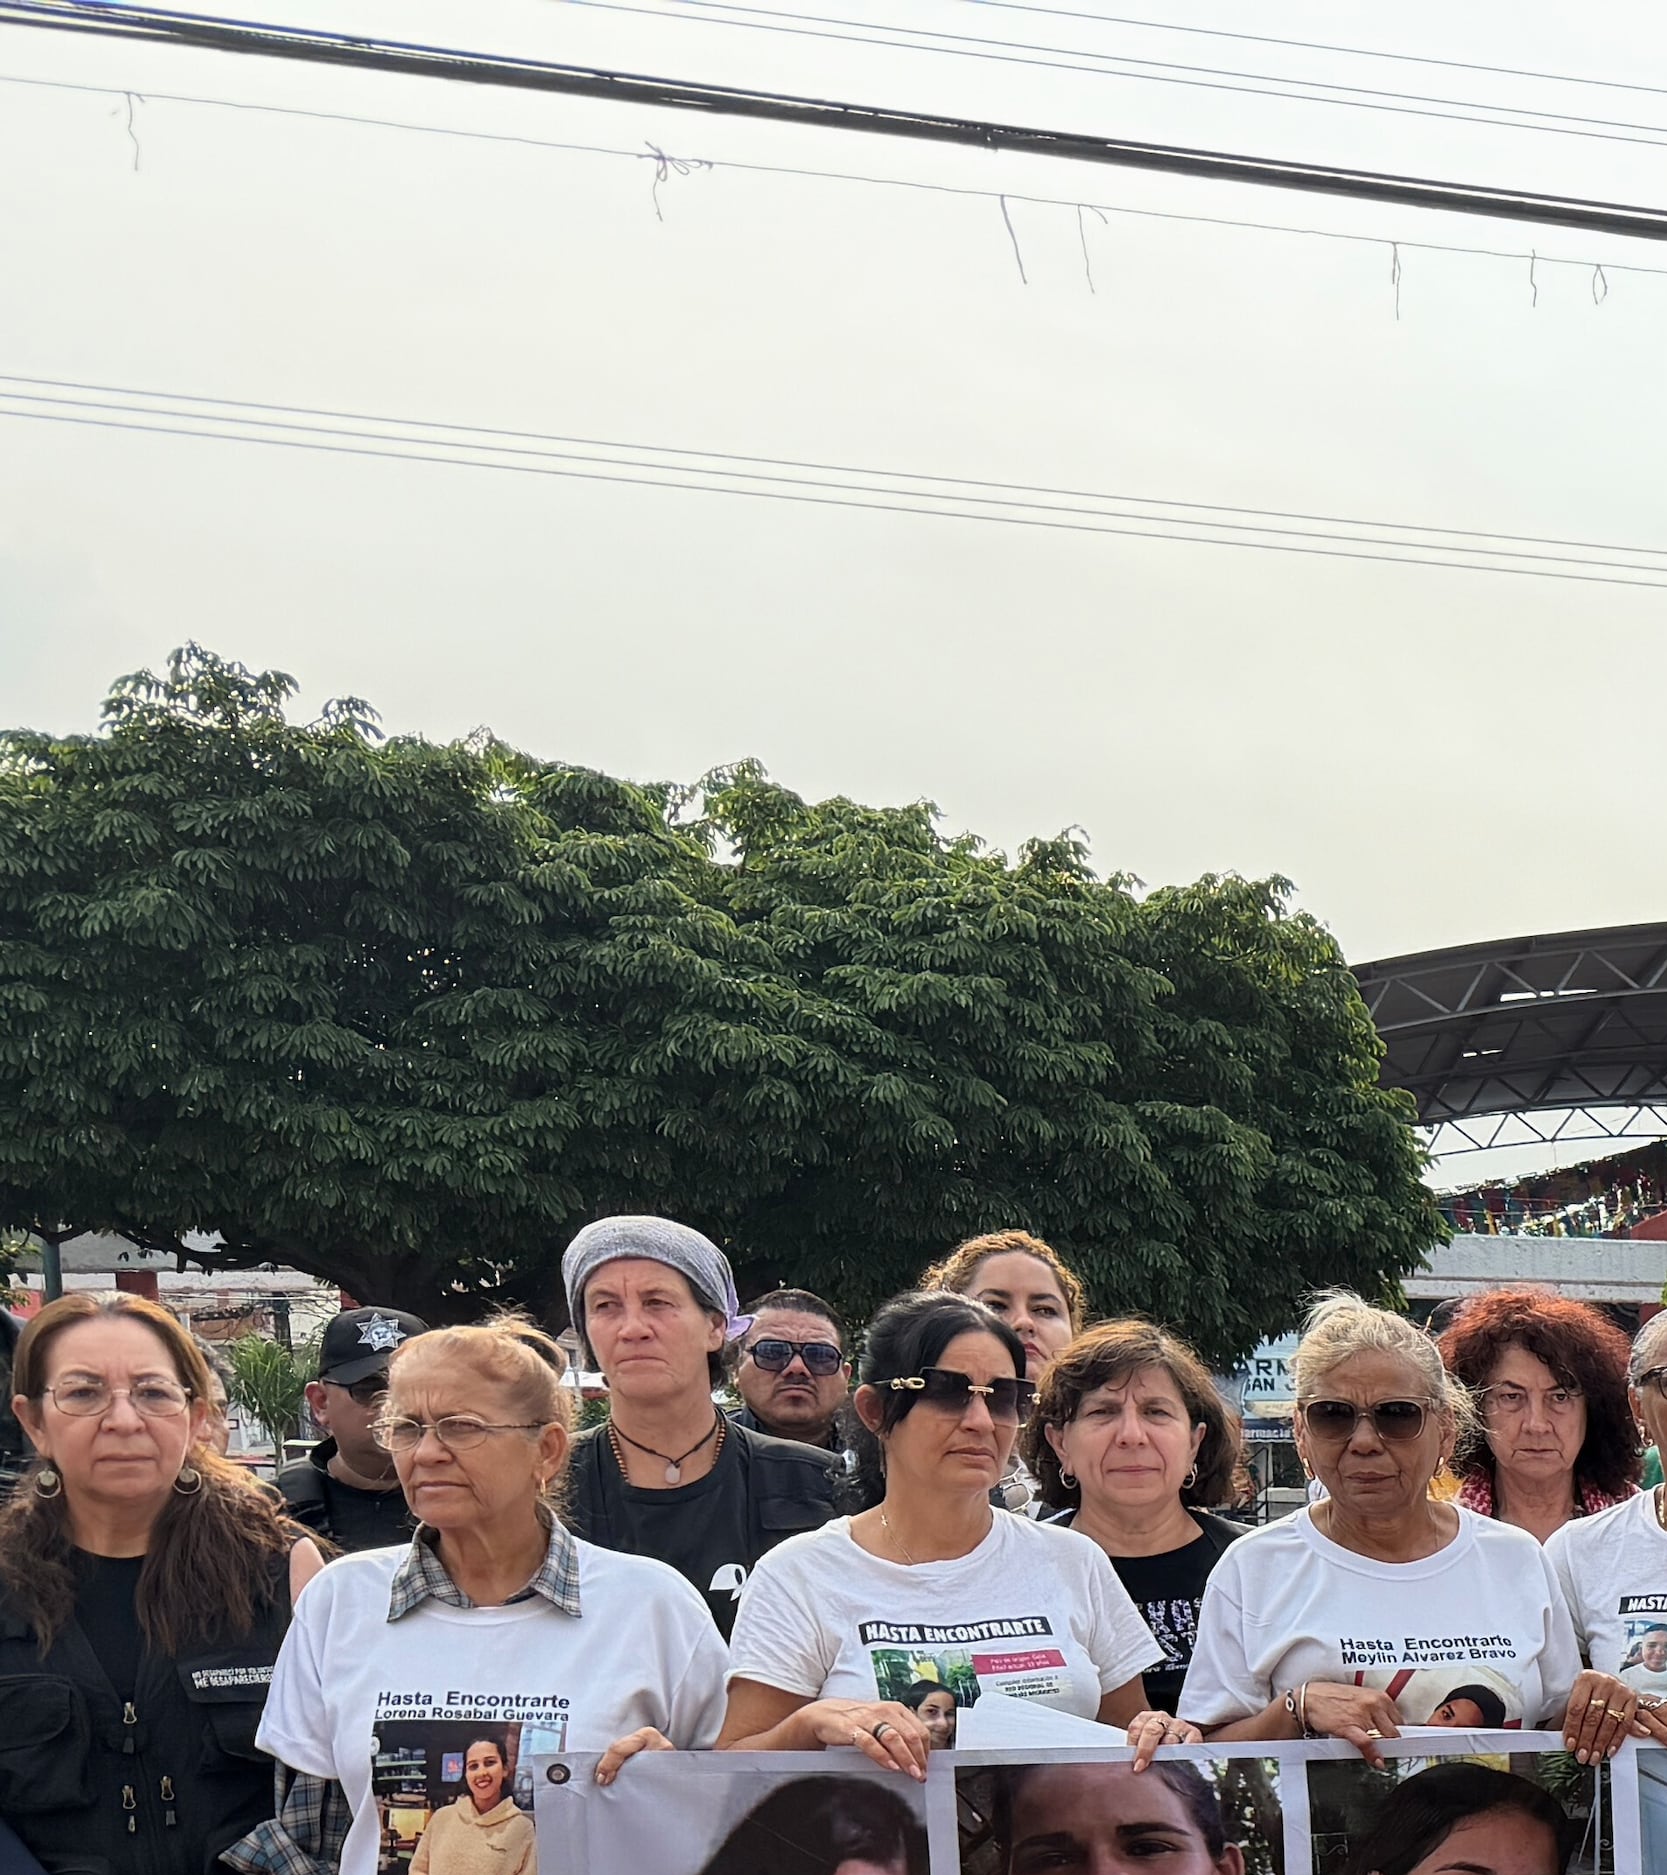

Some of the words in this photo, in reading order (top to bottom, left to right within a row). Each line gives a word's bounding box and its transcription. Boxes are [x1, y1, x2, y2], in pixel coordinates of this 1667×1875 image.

[865, 1620, 923, 1642] HASTA
[924, 1618, 1046, 1643] ENCONTRARTE
[1340, 1637, 1394, 1651] Hasta
[1404, 1634, 1512, 1650] Encontrarte
[1341, 1651, 1397, 1665] Meylin
[1402, 1649, 1466, 1663] Alvarez
[1470, 1648, 1517, 1660] Bravo
[378, 1691, 432, 1707] Hasta
[446, 1691, 570, 1709] Encontrarte
[375, 1708, 426, 1720] Lorena
[432, 1707, 498, 1720] Rosabal
[503, 1708, 569, 1722] Guevara
